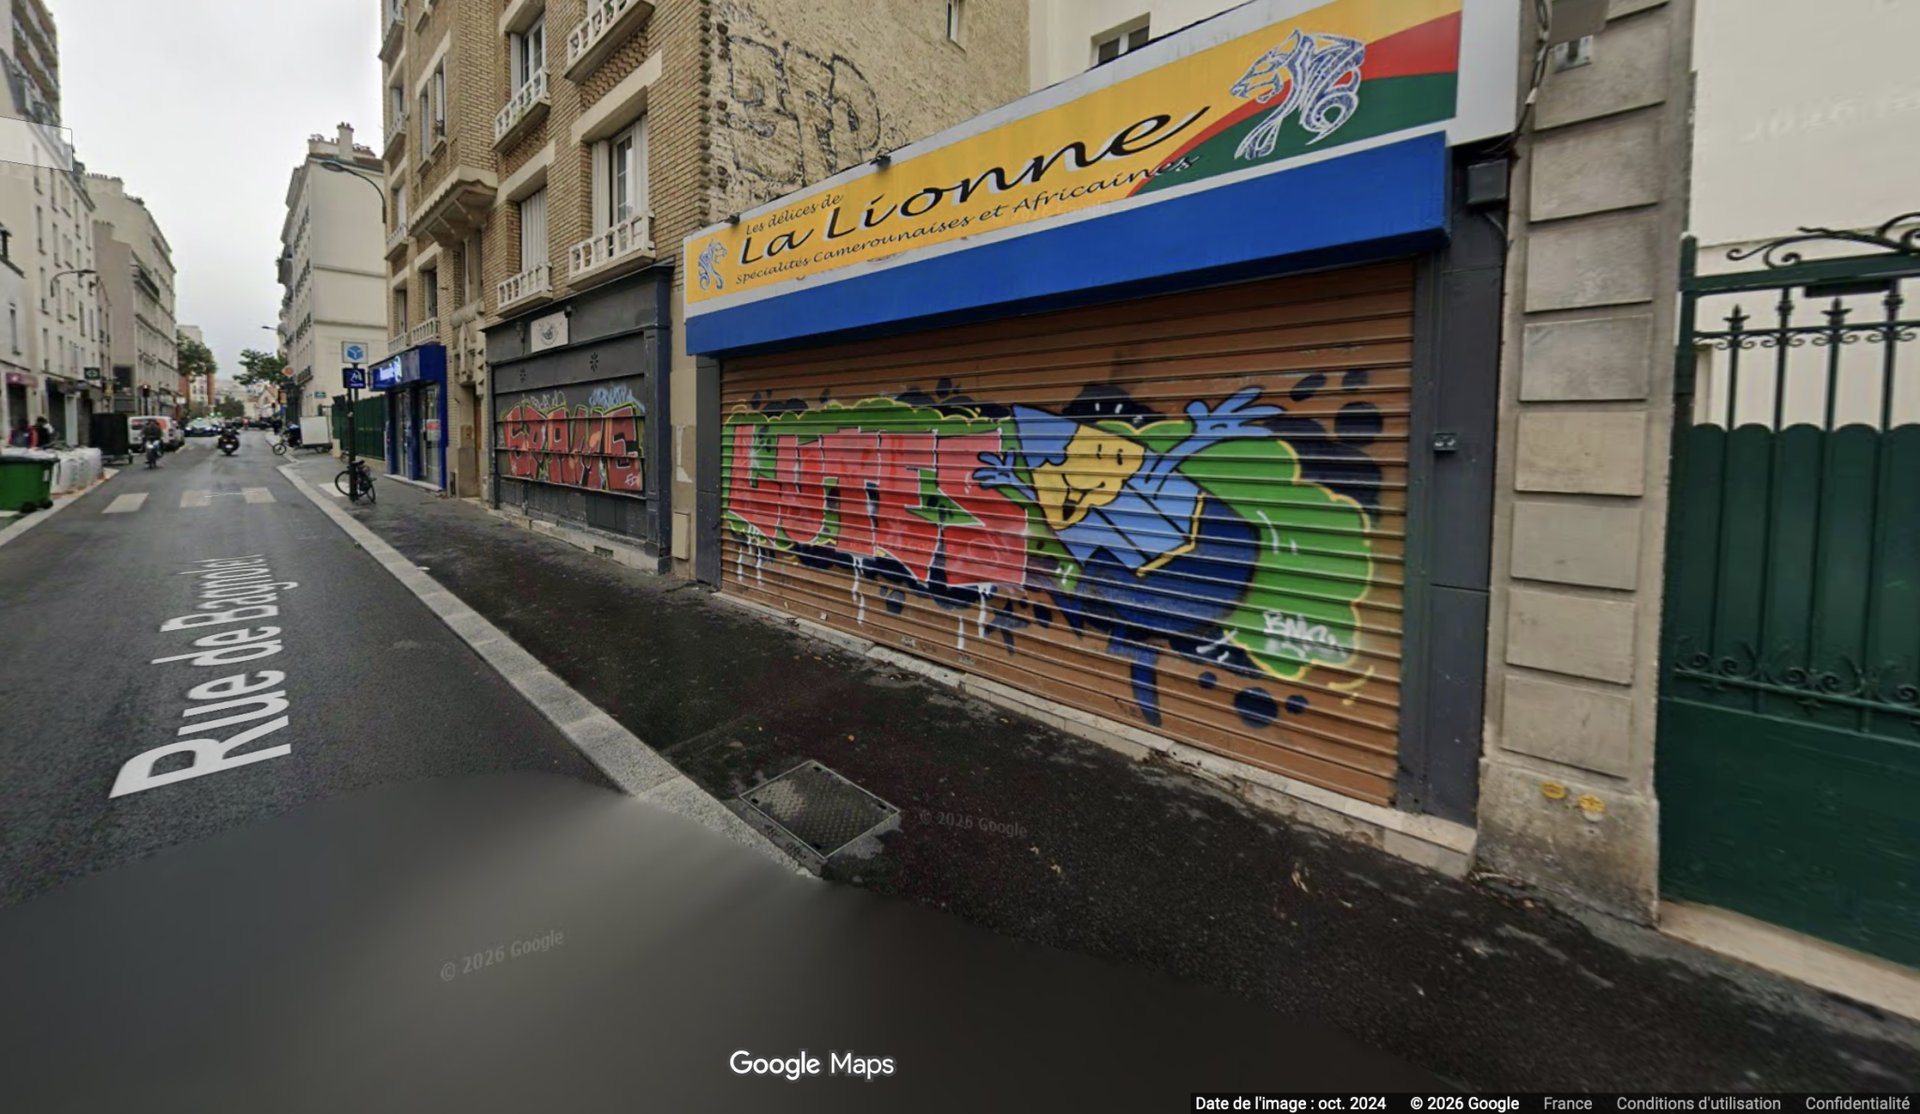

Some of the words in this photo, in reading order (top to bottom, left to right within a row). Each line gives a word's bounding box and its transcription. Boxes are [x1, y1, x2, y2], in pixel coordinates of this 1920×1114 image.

[739, 227, 814, 266] La
[823, 106, 1211, 241] Lionne
[746, 221, 764, 236] Les
[768, 205, 816, 228] délices
[820, 193, 844, 211] de
[813, 214, 976, 263] Camerounaises
[979, 204, 1009, 222] et
[1013, 154, 1201, 214] Africaines
